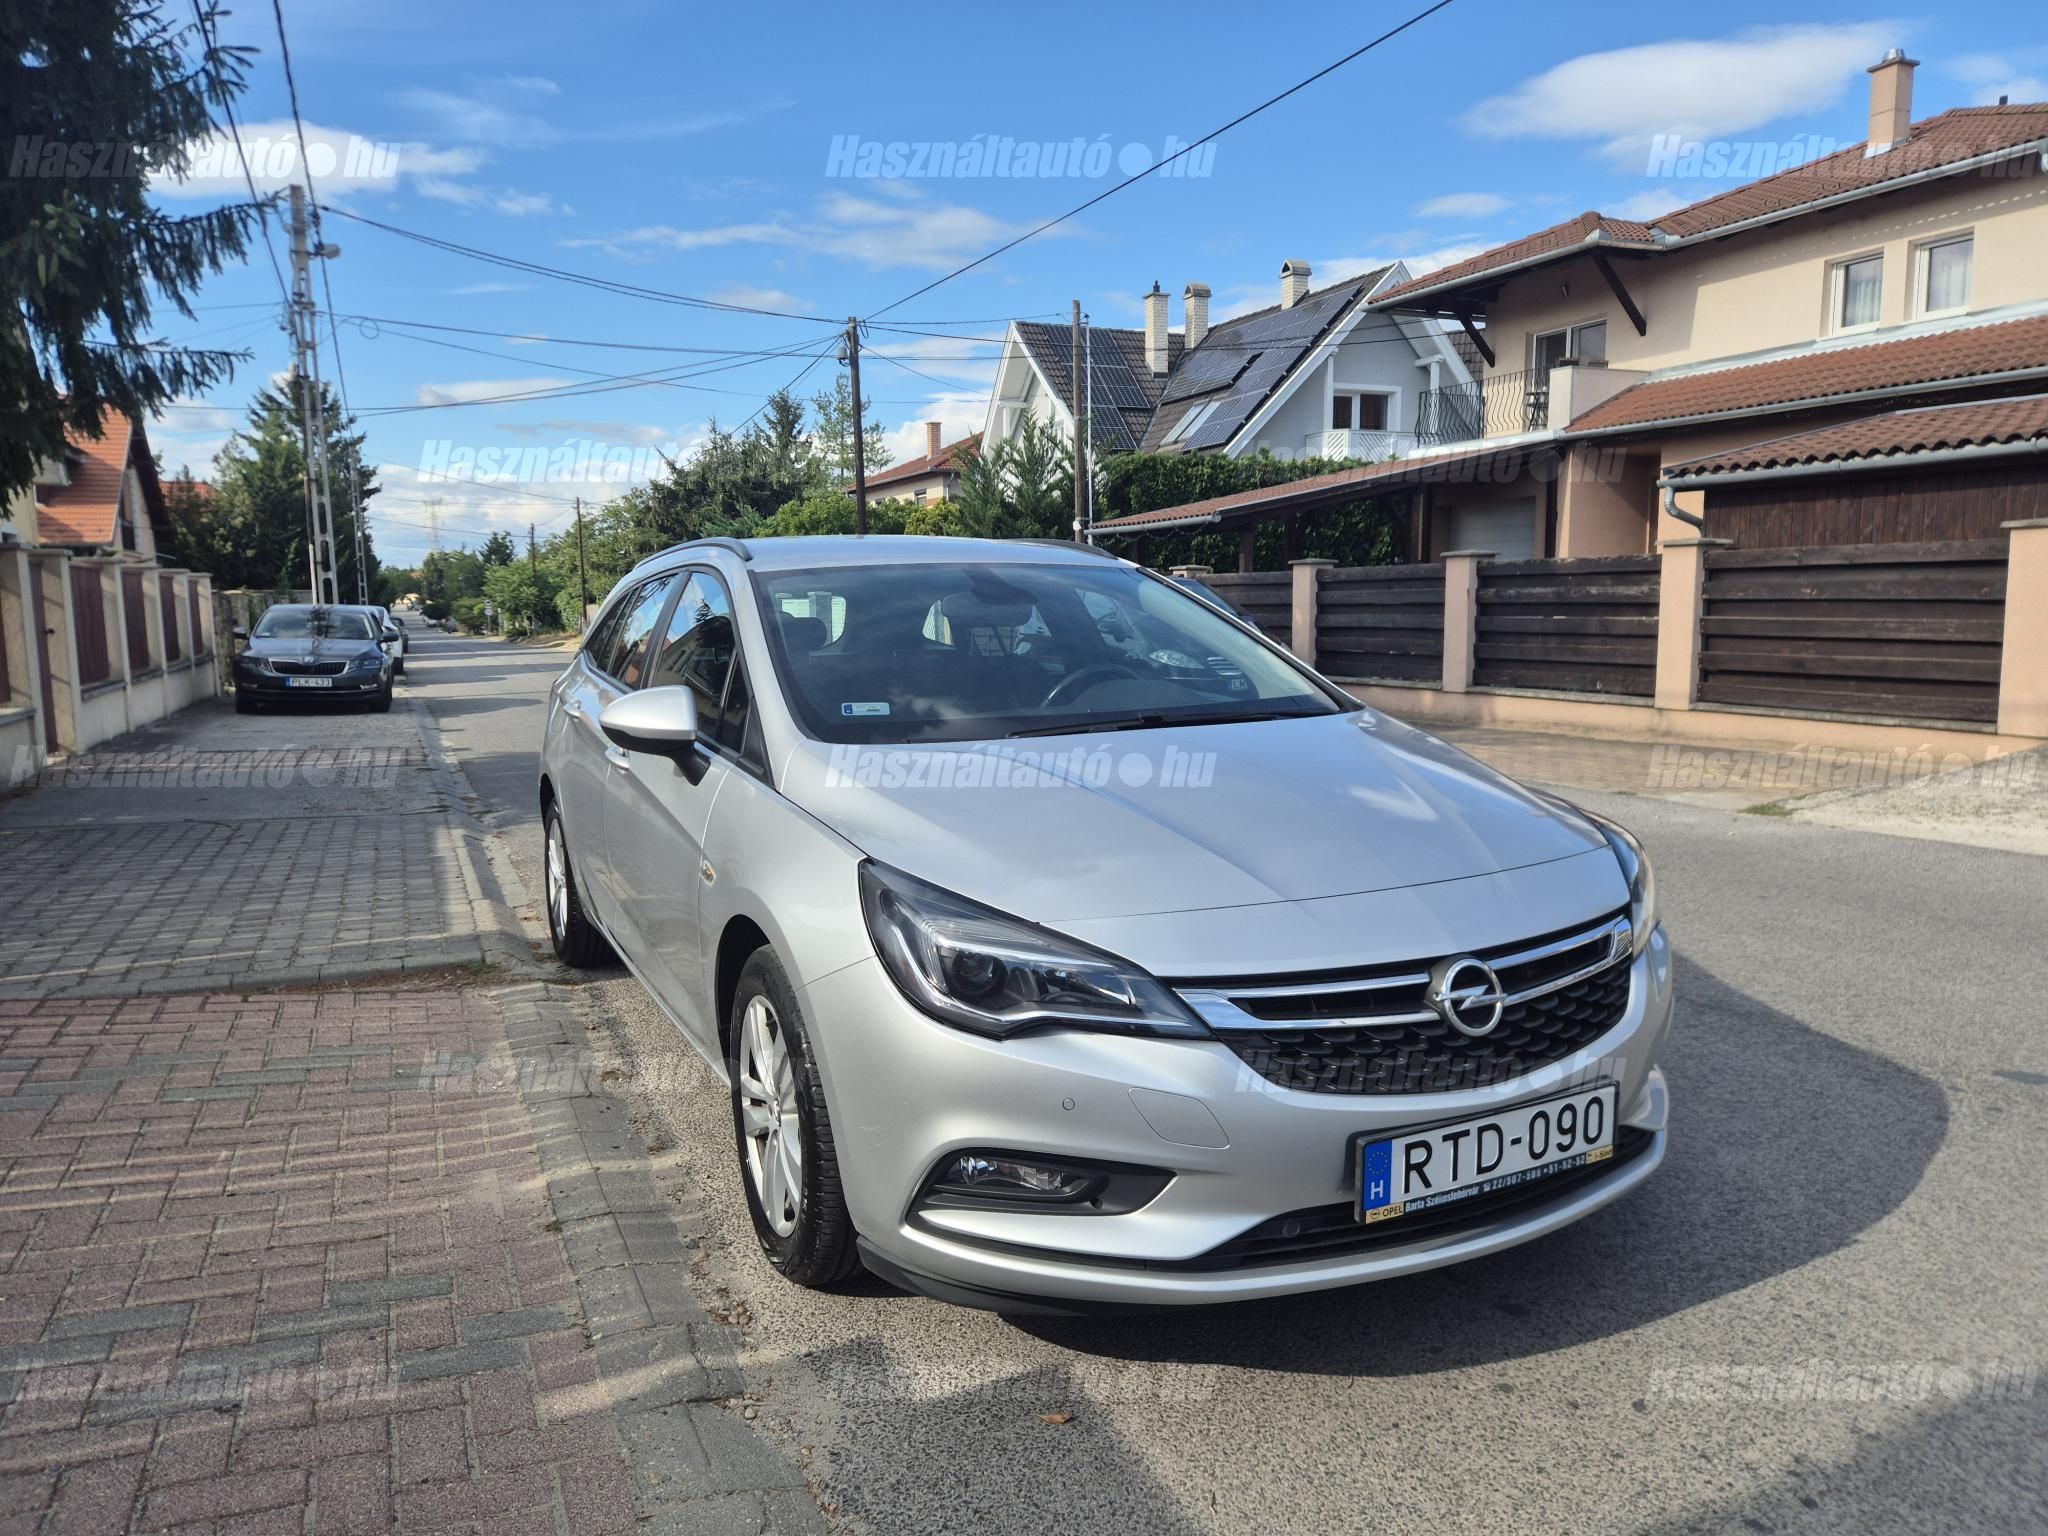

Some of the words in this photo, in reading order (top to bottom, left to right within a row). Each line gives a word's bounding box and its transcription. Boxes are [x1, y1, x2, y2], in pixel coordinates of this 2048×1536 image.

[1403, 1096, 1604, 1194] RTD-090
[1370, 1179, 1384, 1200] H
[1382, 1204, 1403, 1217] OPEL
